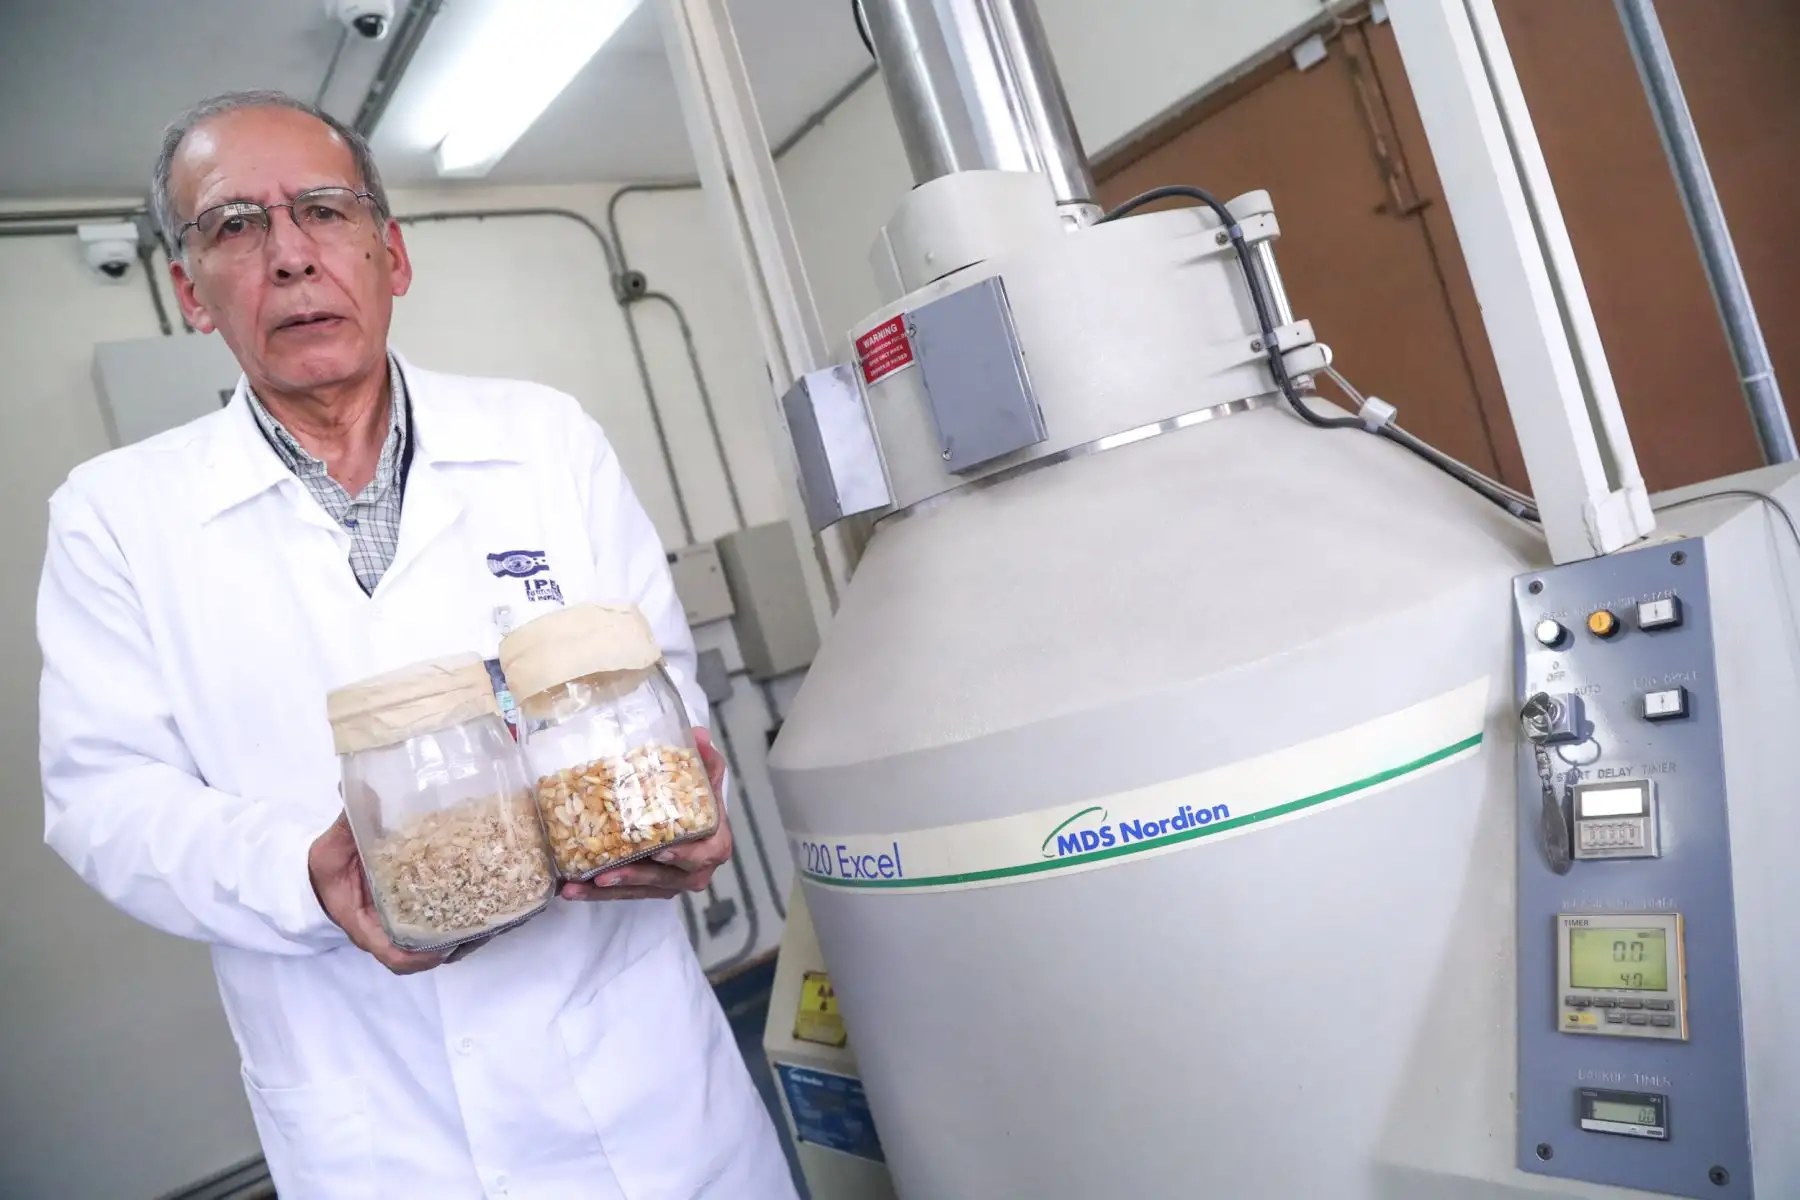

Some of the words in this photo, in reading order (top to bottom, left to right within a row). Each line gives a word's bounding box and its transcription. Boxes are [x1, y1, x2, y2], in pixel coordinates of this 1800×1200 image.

[863, 324, 898, 348] WARNING
[1546, 671, 1566, 683] OFF
[1574, 684, 1601, 697] AUTO
[1597, 766, 1633, 779] DELAY
[1641, 760, 1678, 775] TIMER
[1056, 824, 1116, 857] MDS
[1122, 804, 1230, 843] Nordion
[802, 841, 832, 876] 220
[836, 842, 903, 879] Excel
[1564, 919, 1589, 927] TIMER
